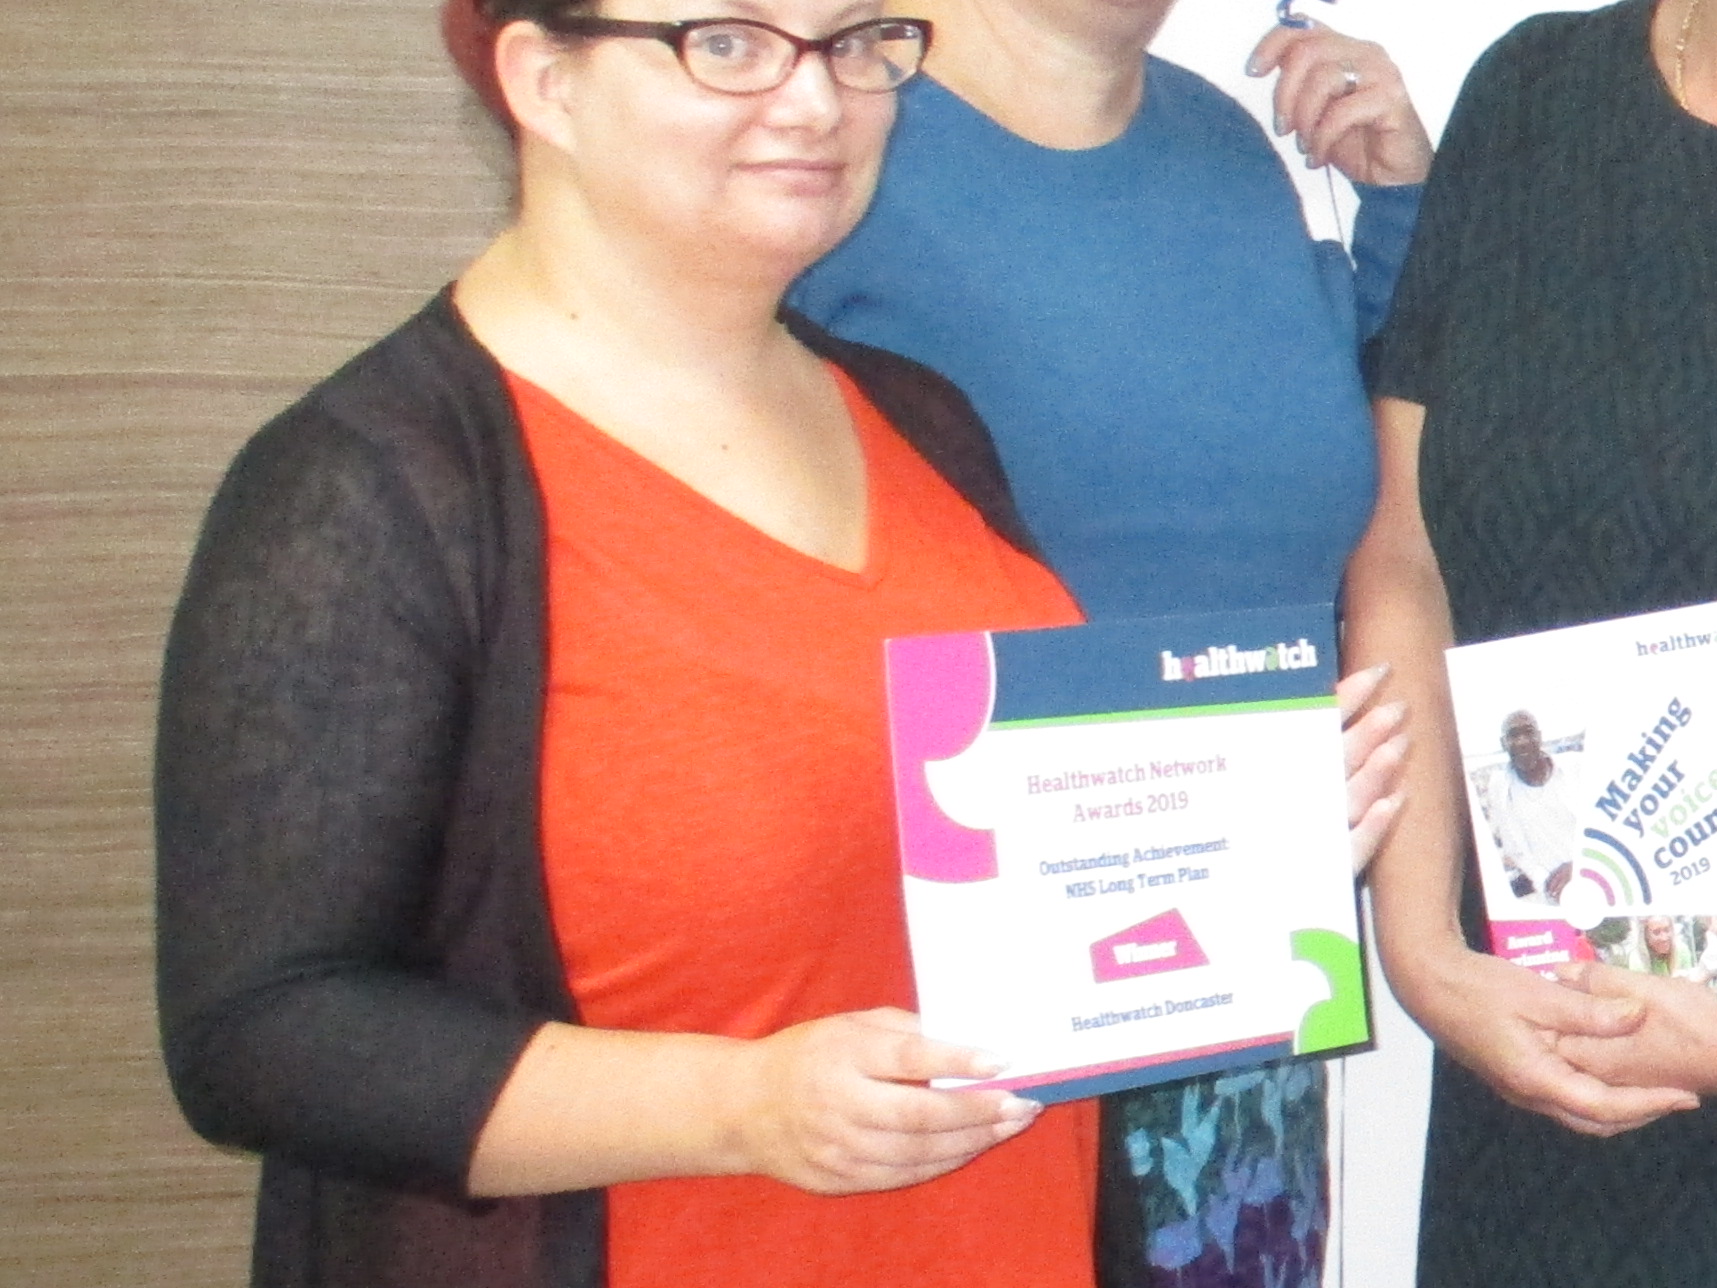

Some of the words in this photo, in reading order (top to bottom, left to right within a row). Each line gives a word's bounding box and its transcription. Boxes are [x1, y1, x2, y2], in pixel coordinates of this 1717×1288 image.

[1160, 638, 1318, 682] healthwatch
[1027, 763, 1147, 795] Healthwatch
[1149, 754, 1228, 780] Network
[1595, 696, 1693, 822] Making
[1072, 797, 1144, 823] Awards
[1147, 790, 1189, 813] 2019
[1622, 759, 1686, 838] your
[1039, 851, 1130, 876] Outstanding
[1132, 837, 1230, 863] Achievement
[1669, 856, 1712, 887] 2019
[1065, 880, 1097, 899] NHS
[1098, 877, 1136, 895] Long
[1136, 871, 1176, 889] Term
[1177, 866, 1210, 883] Plan
[1071, 1002, 1163, 1032] Healthwatch
[1164, 992, 1234, 1016] Doncaster
